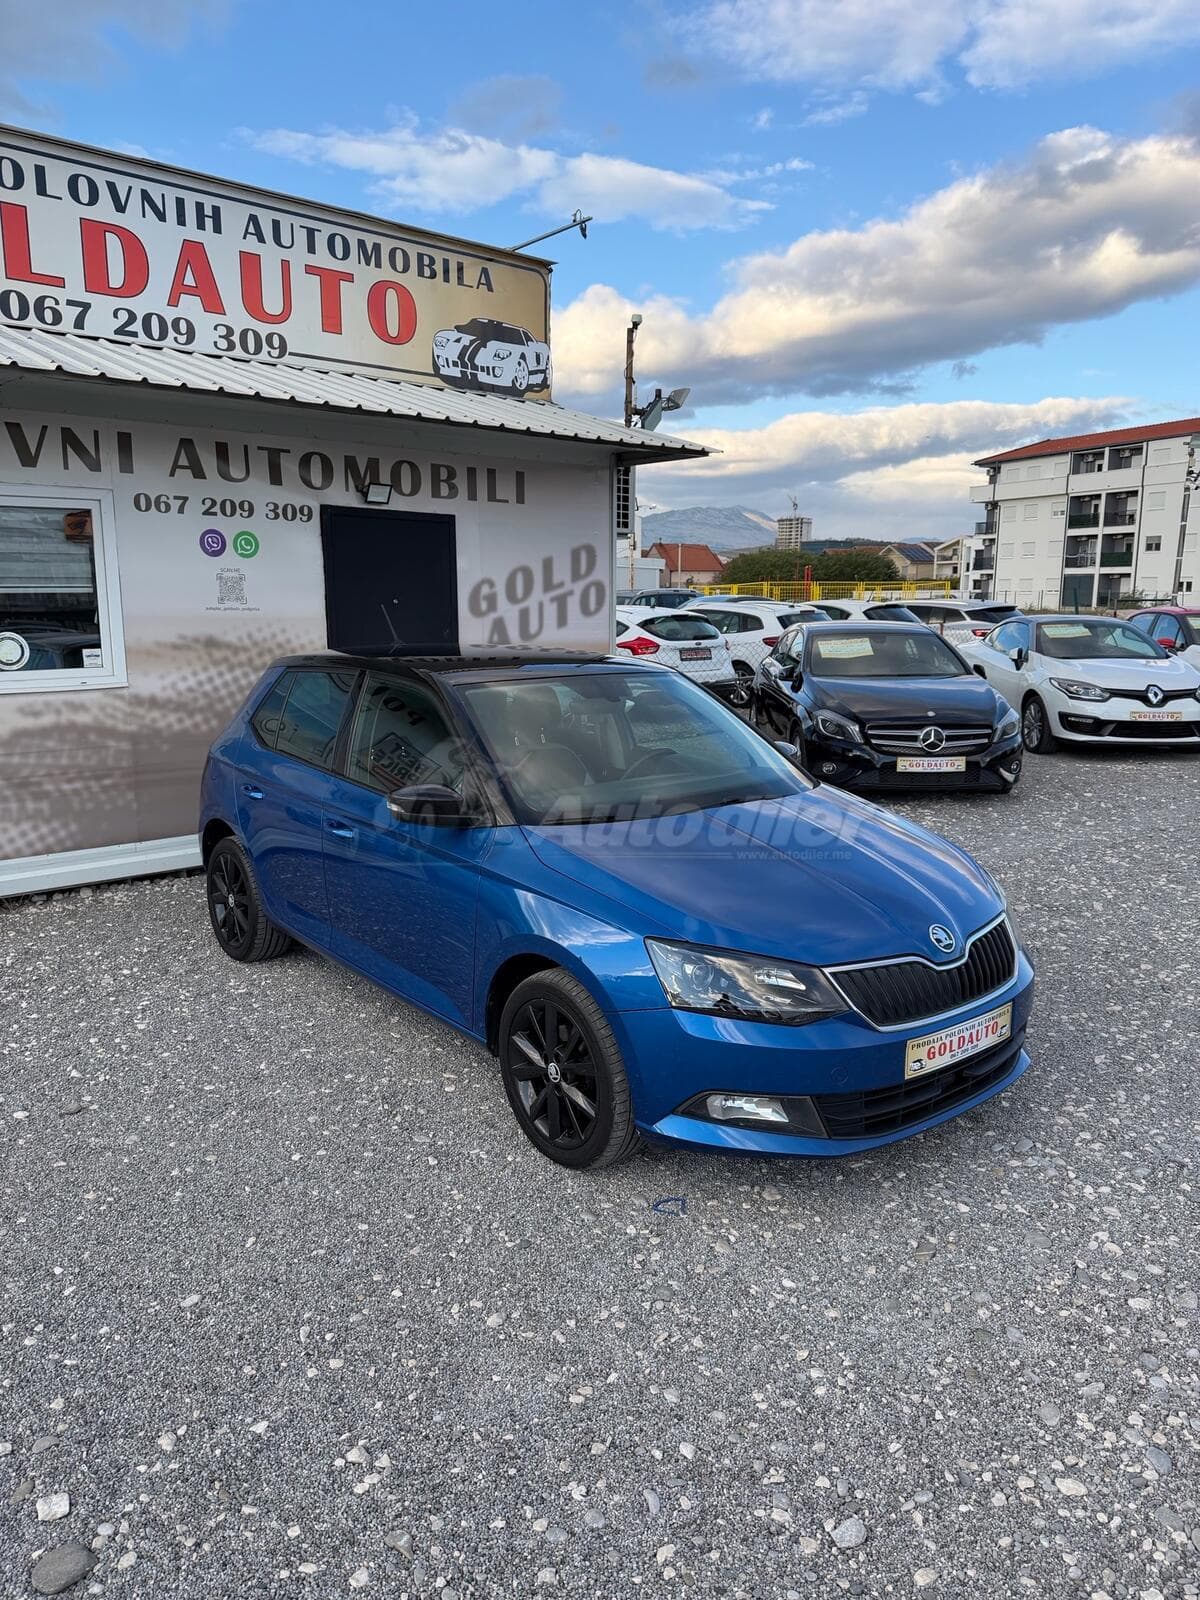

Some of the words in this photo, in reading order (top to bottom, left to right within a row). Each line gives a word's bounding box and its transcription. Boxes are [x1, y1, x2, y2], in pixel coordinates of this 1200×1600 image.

[0, 201, 418, 346] LDAUTO
[242, 212, 494, 293] AUTOMOBILA
[0, 289, 92, 331] 067
[112, 307, 197, 347] 209
[212, 323, 288, 360] 309
[3, 421, 134, 474] VNI
[168, 437, 526, 505] AUTOMOBILI
[133, 492, 190, 515] 067
[201, 498, 255, 518] 209
[265, 502, 314, 523] 309
[467, 543, 597, 619] GOLD
[487, 579, 607, 645] AUTO
[911, 1036, 943, 1051] PRODAJA
[926, 1020, 999, 1061] GOLDAUTO
